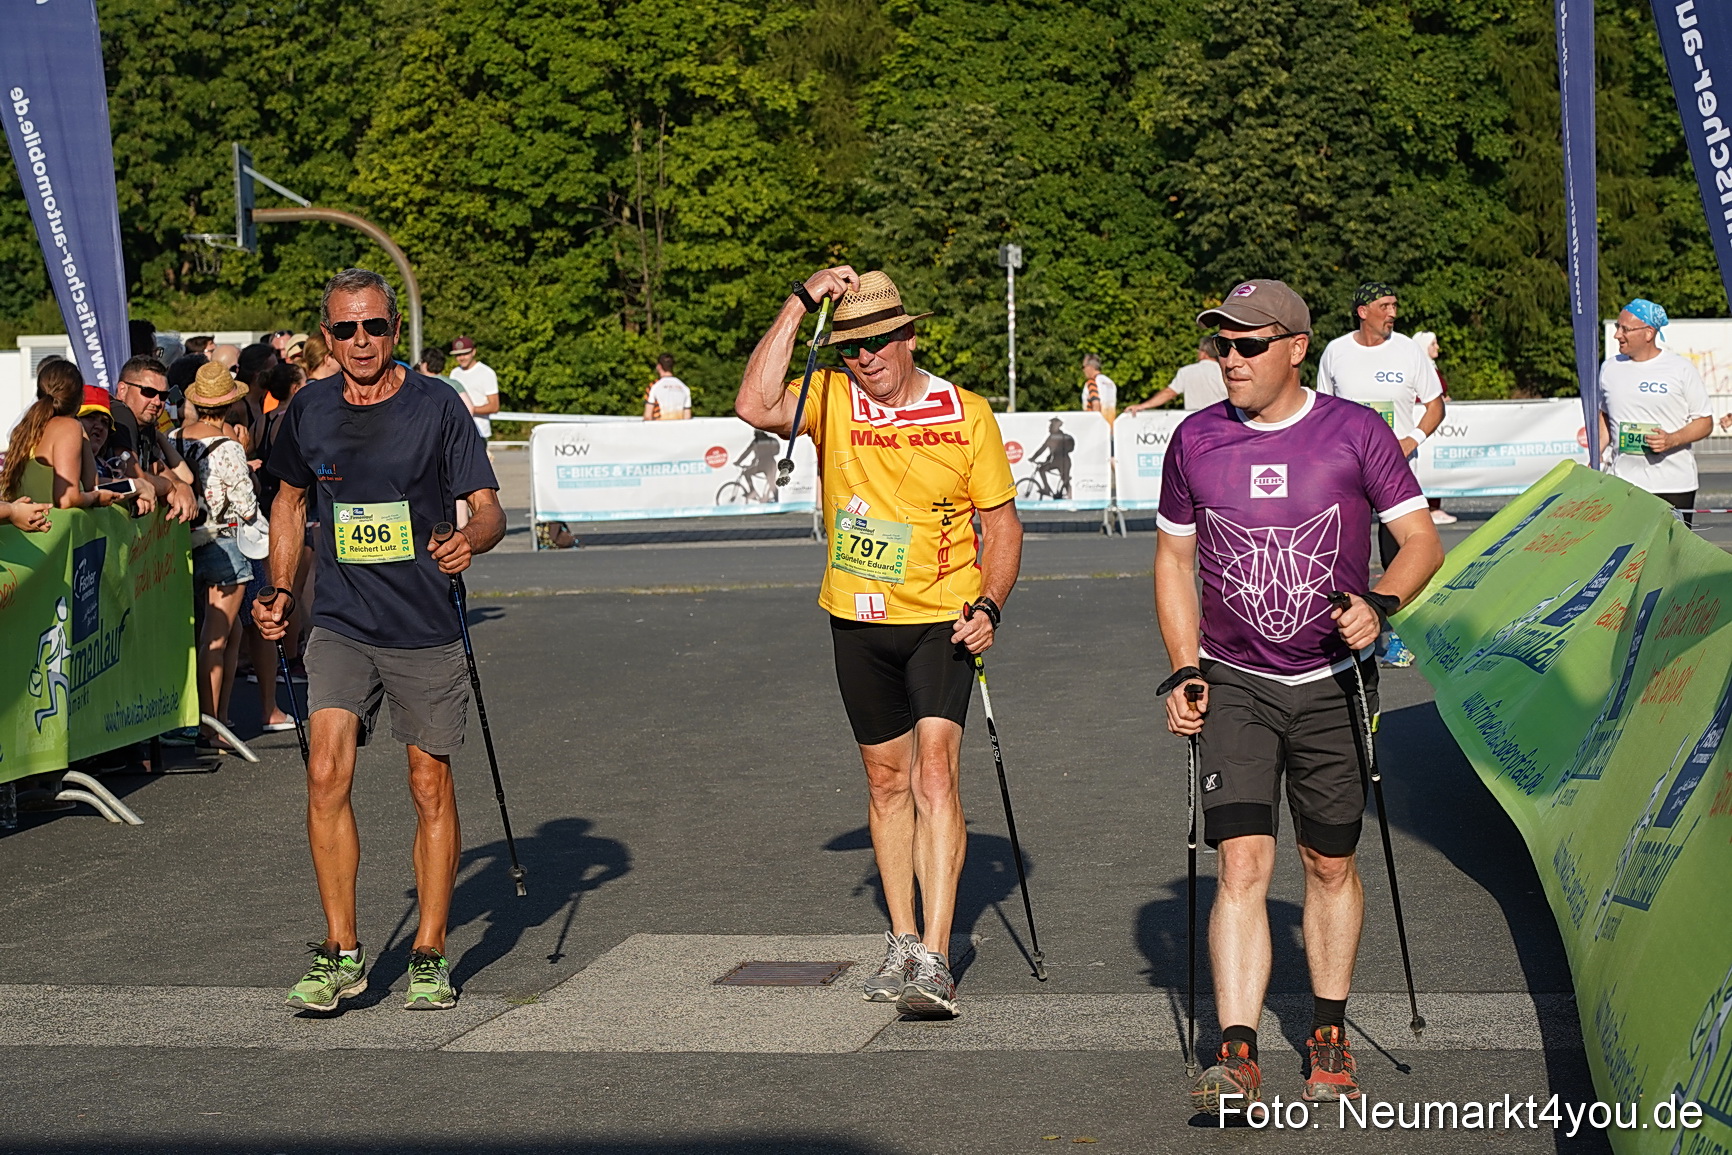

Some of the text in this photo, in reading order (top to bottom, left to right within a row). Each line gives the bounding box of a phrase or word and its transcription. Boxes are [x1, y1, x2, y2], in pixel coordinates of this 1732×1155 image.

[1375, 371, 1404, 383] ecs
[1638, 381, 1668, 394] ecs
[850, 427, 970, 449] MAX BÖGL
[1136, 432, 1170, 445] NOW
[554, 443, 590, 457] NOW
[1435, 442, 1579, 459] E-BIKES & FAHRRÄDER
[317, 463, 336, 475] aha!
[558, 460, 707, 478] E-BIKES & FAHRRÄDER
[1253, 477, 1285, 485] FUCHS
[338, 526, 346, 555] WALK
[351, 523, 391, 544] 496
[400, 525, 409, 551] 2022
[835, 532, 844, 561] WALK
[849, 534, 889, 560] 797
[867, 560, 895, 571] Eduard
[894, 547, 905, 575] 2022
